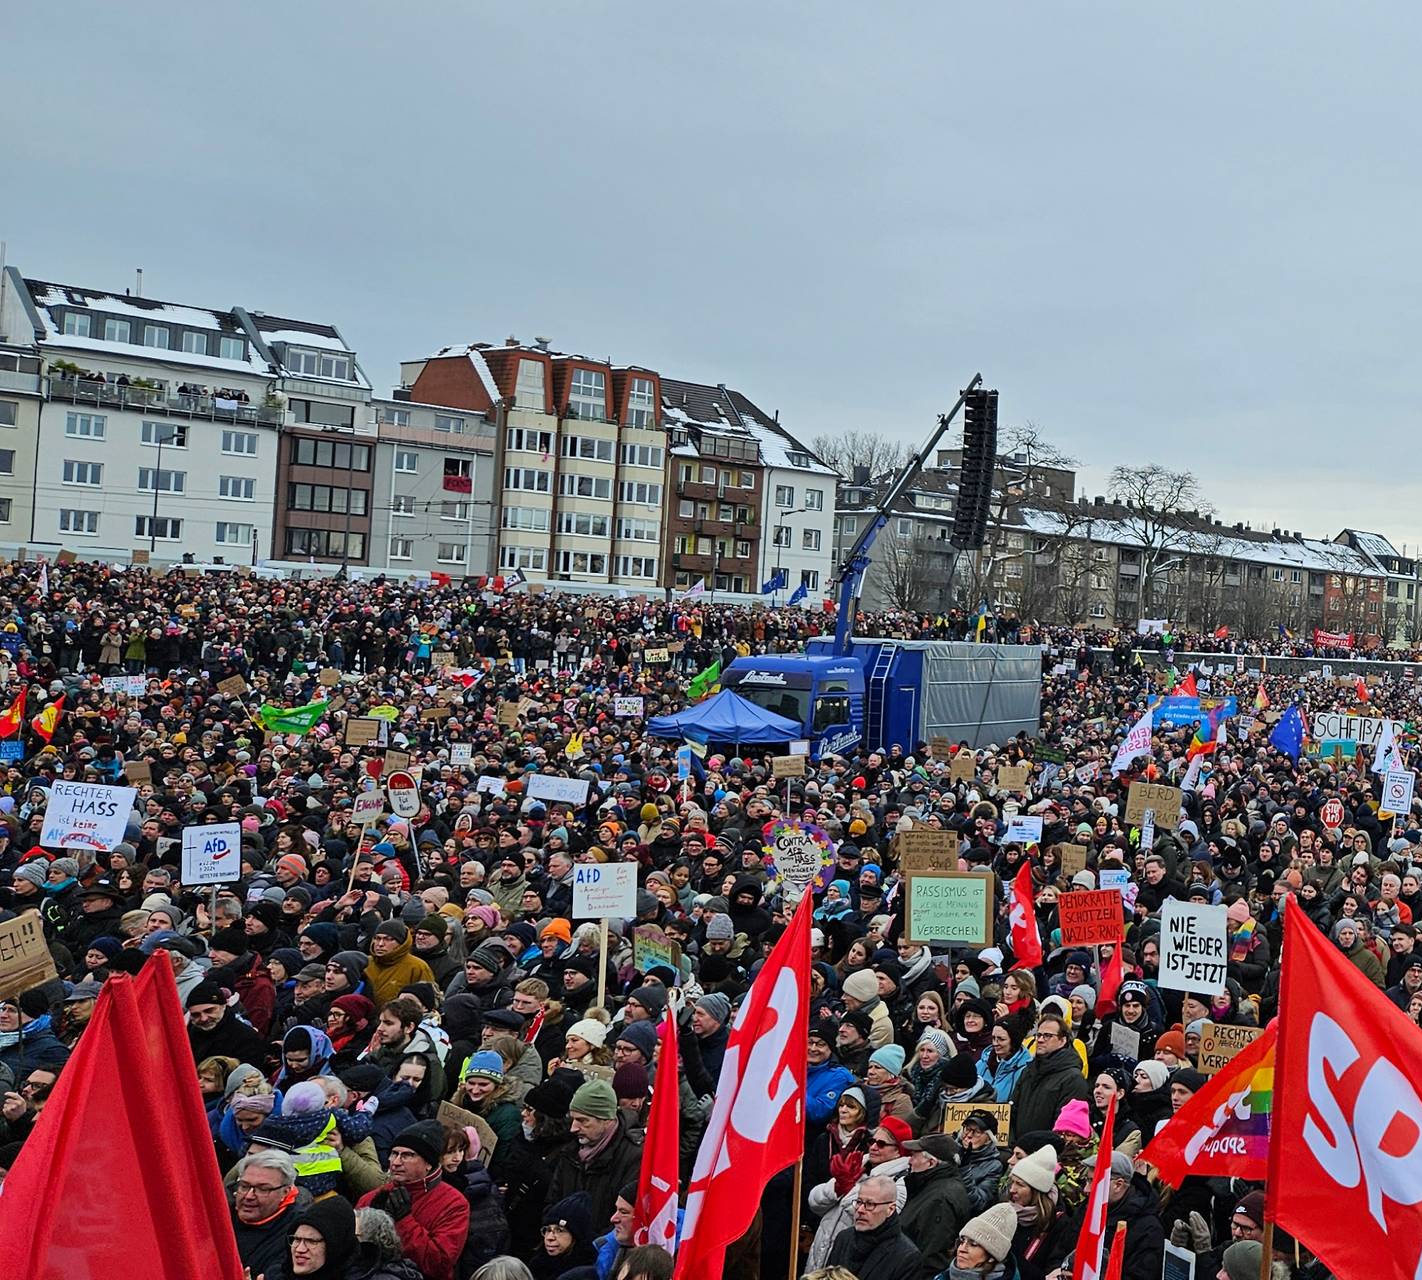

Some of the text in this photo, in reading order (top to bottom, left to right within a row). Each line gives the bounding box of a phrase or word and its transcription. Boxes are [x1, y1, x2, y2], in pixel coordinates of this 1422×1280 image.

[55, 784, 112, 799] RECHTER
[71, 799, 118, 817] HASS
[204, 838, 226, 854] AfD
[777, 836, 812, 851] CONTRA
[794, 855, 815, 864] HASS
[576, 868, 601, 883] AfD
[916, 885, 967, 898] RASSISMUS
[1060, 891, 1120, 909] DEMOKRATIE
[917, 924, 979, 936] VERBRECHEN
[1170, 917, 1197, 934] NIE
[1062, 926, 1094, 943] NAZIS
[1173, 936, 1223, 958] WIEDER
[1167, 952, 1227, 984] IST JETZT
[1213, 1026, 1253, 1042] RECHTS
